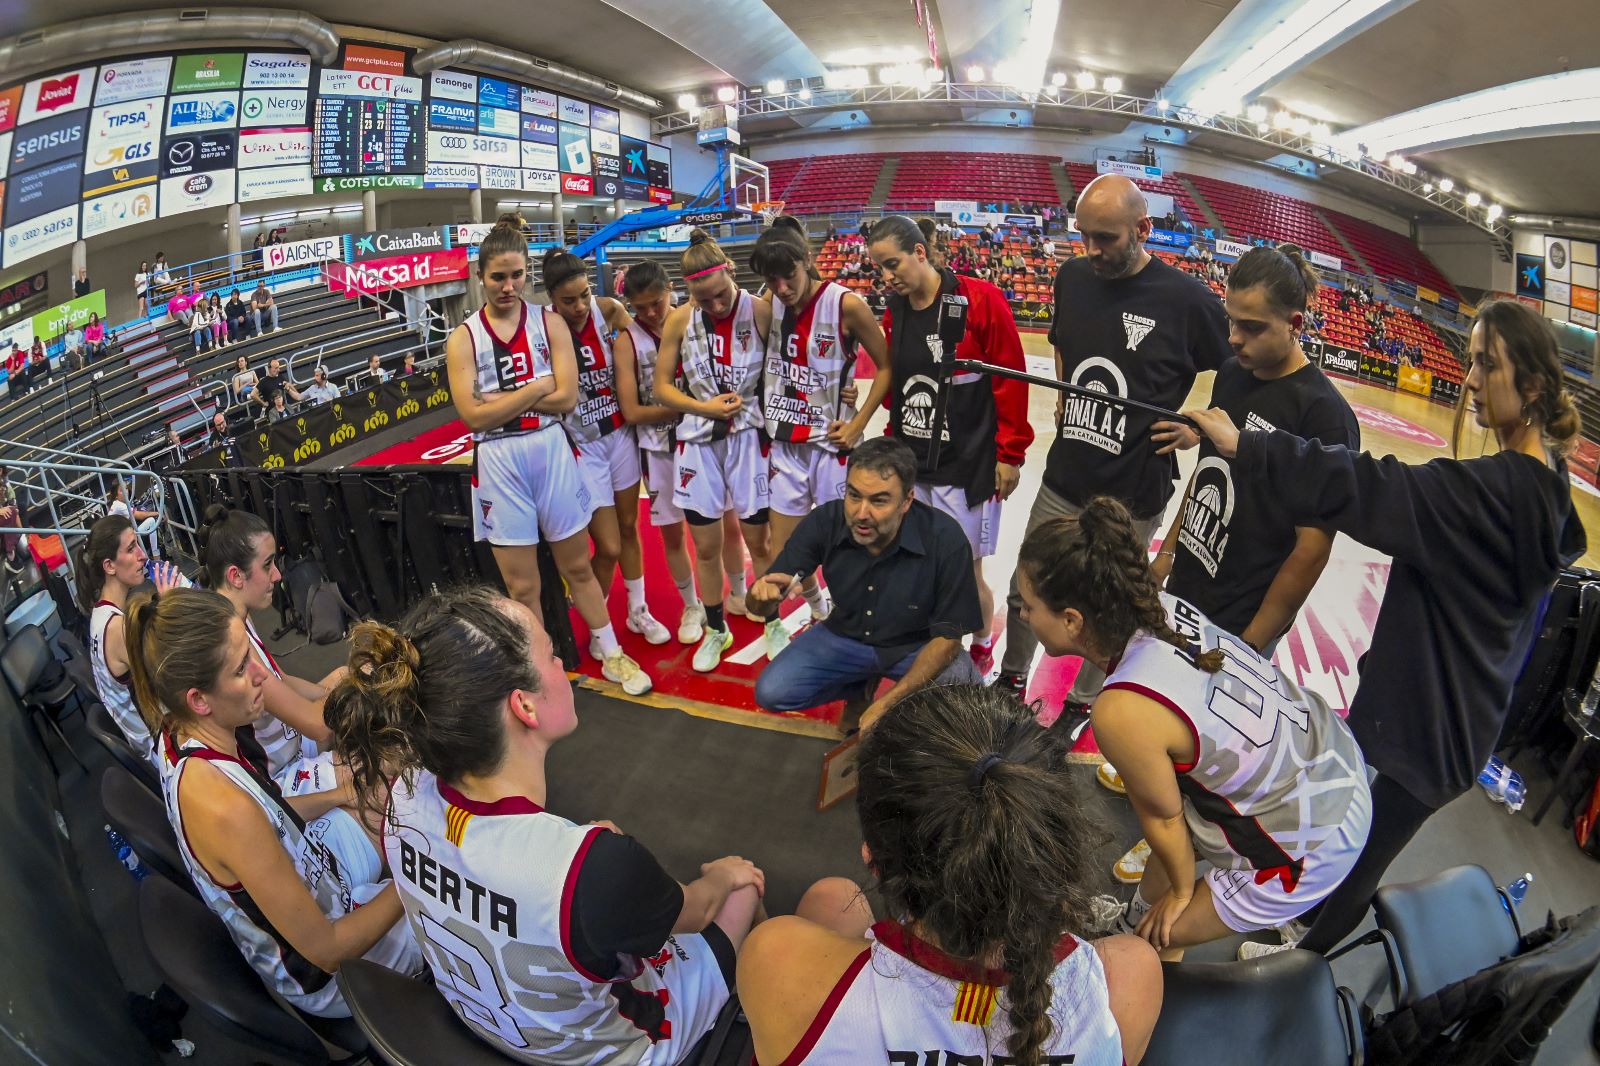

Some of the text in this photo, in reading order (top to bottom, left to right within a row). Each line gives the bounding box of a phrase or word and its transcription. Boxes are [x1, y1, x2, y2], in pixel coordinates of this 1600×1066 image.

[249, 59, 307, 69] Sagalés
[346, 55, 404, 68] www.gctplus.com
[357, 75, 414, 98] GCT plus
[435, 77, 473, 90] canonge
[40, 84, 73, 102] Joviat
[267, 96, 306, 111] Nergy
[431, 104, 475, 117] FRAMUN
[108, 111, 146, 128] TIPSA
[376, 119, 385, 130] 27
[15, 125, 82, 157] sensus
[472, 138, 508, 153] sarsa
[124, 141, 152, 160] GLS
[190, 174, 207, 186] café
[485, 167, 516, 178] BROWN
[527, 171, 553, 181] JOYSA
[188, 182, 208, 192] crem
[339, 176, 416, 188] COTS CLARET
[486, 178, 516, 188] TAILOR
[43, 216, 73, 236] sarsa
[685, 212, 723, 223] endesa
[376, 229, 442, 252] CaixaBank
[285, 239, 335, 261] AIGNEP
[345, 254, 432, 293] Macsa id
[786, 333, 800, 358] 6
[580, 345, 596, 367] 9
[1324, 353, 1358, 372] SPALDING
[499, 351, 529, 380] 23
[1115, 414, 1127, 442] 4
[1077, 431, 1119, 452] CATALUNYA
[400, 837, 518, 939] BERTA
